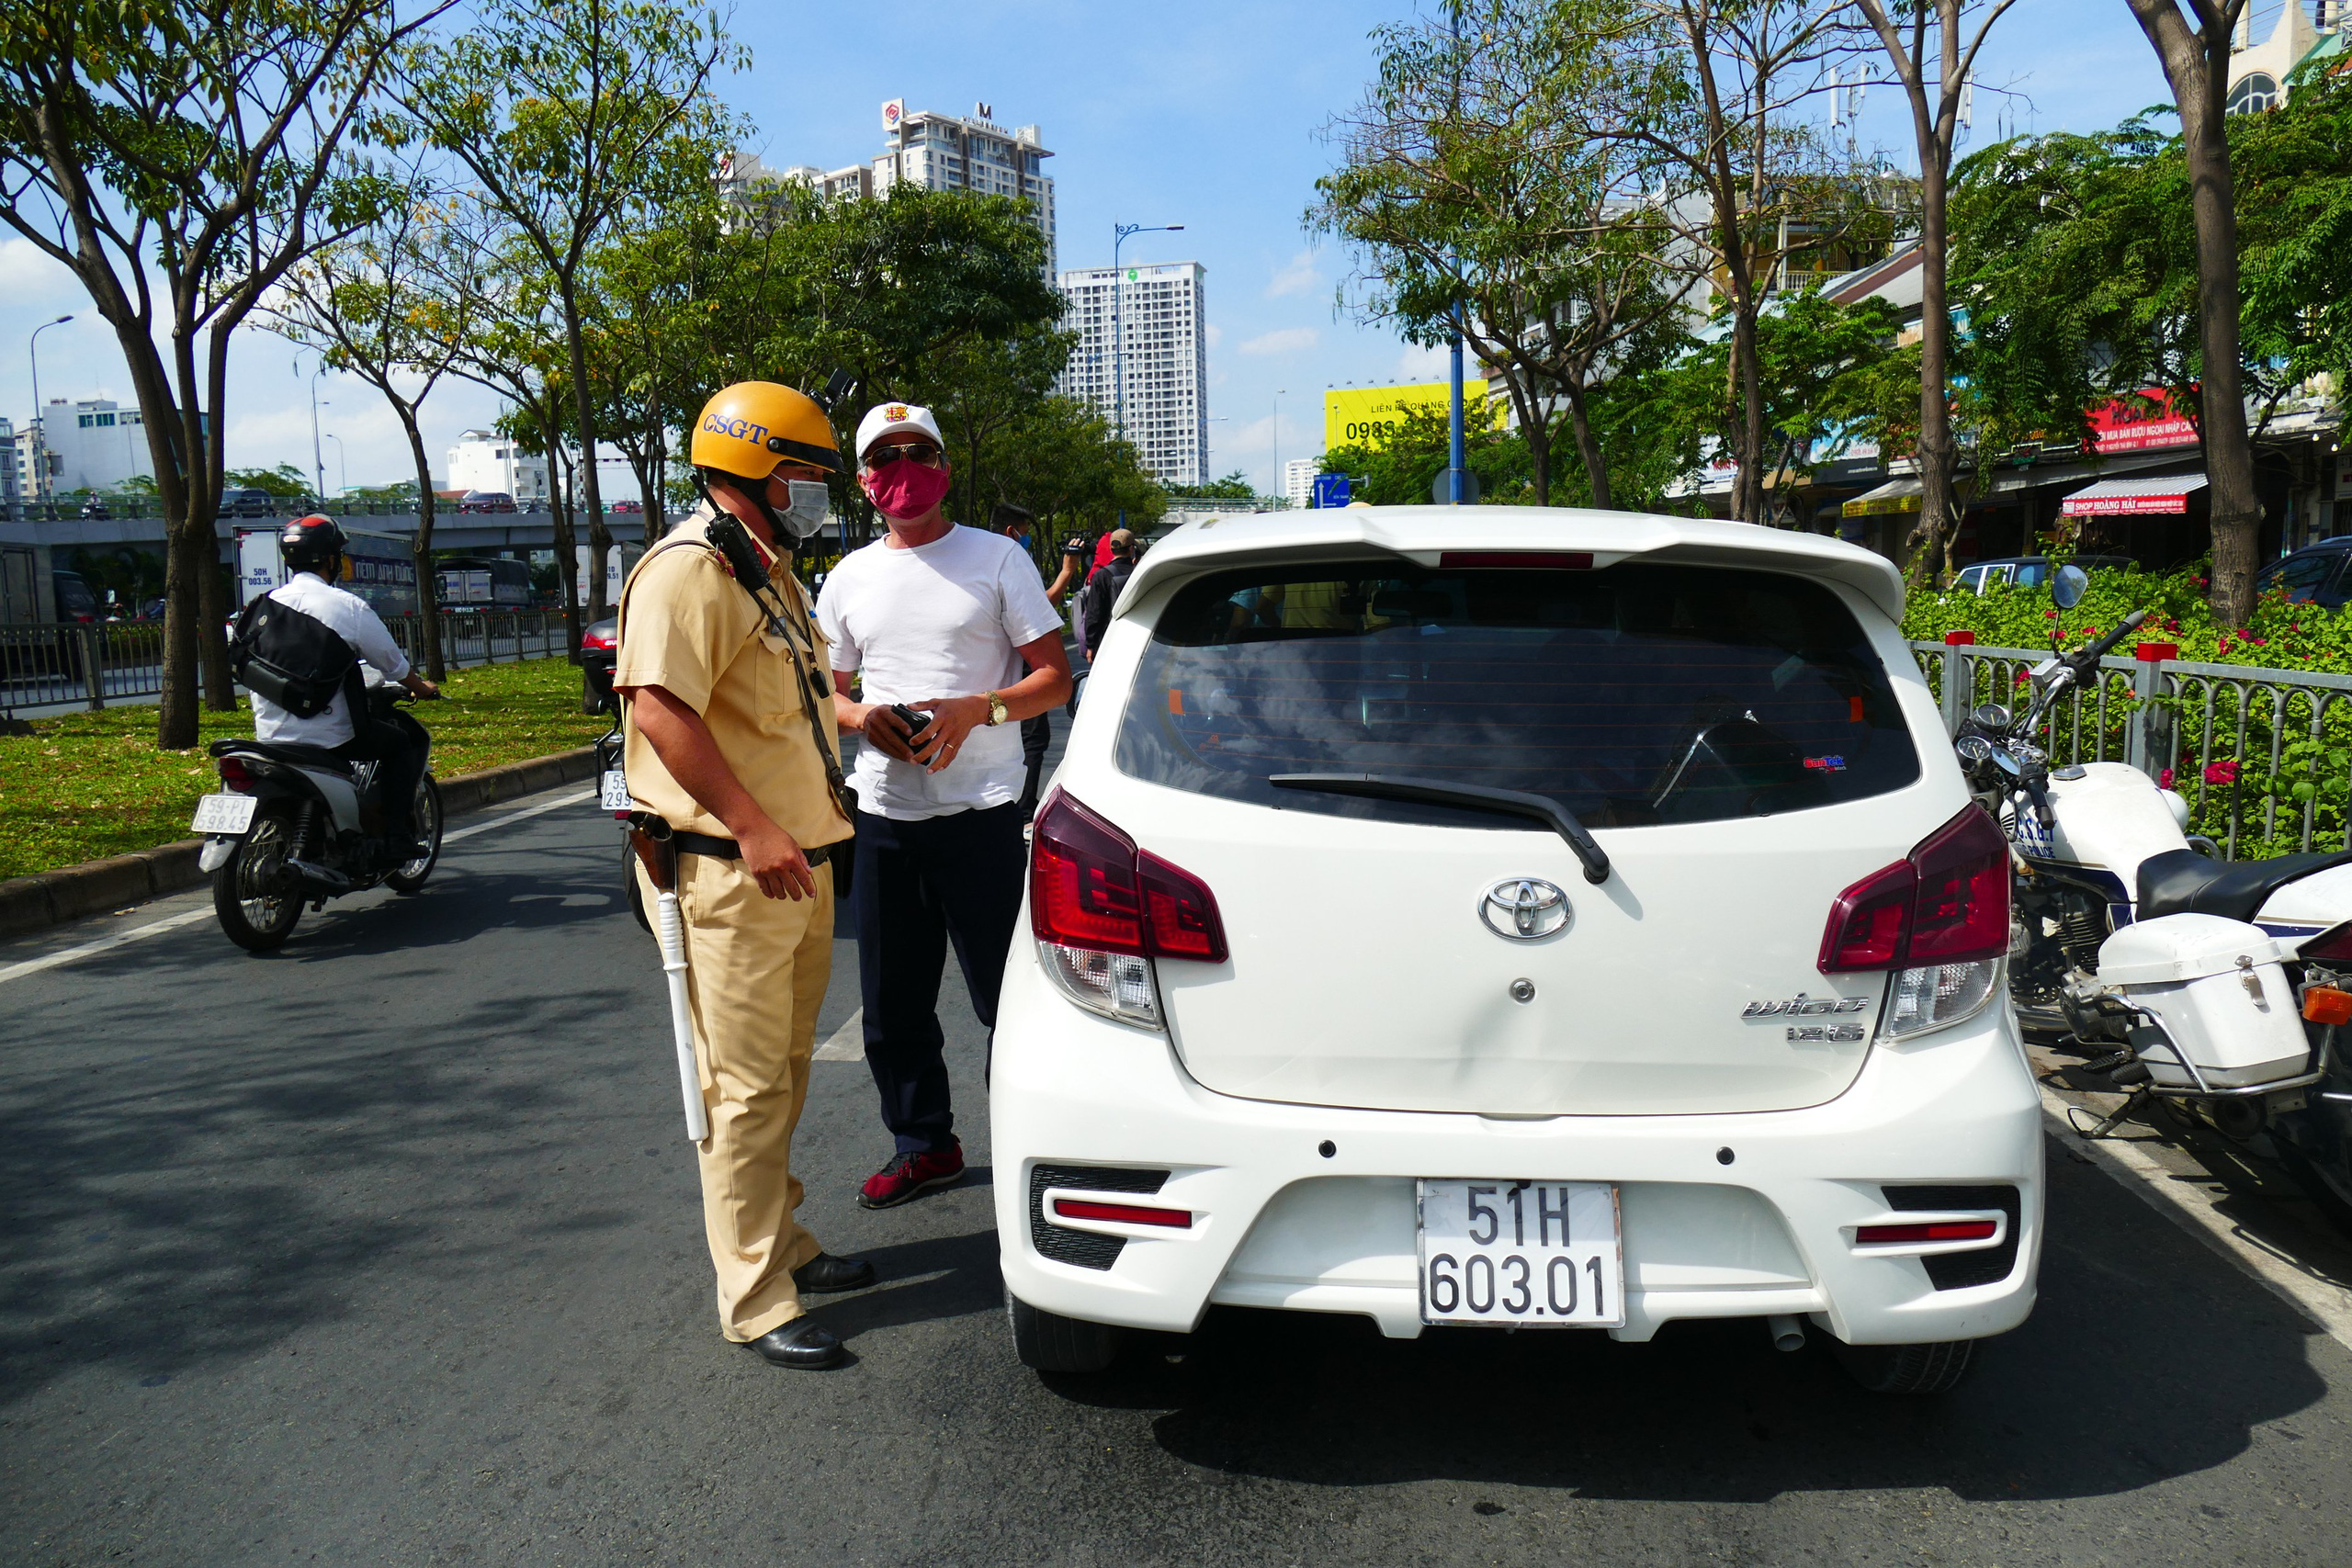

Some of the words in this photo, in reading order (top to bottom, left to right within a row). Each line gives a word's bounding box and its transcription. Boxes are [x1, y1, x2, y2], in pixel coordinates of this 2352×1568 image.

[1371, 402, 1392, 413] LIÊN
[703, 413, 769, 445] CSGT
[2107, 429, 2119, 441] MUA
[2119, 426, 2131, 439] BÁN
[2146, 423, 2165, 436] NGOẠI
[2075, 502, 2094, 511] SHOP
[2094, 499, 2120, 511] HOÀNG
[2121, 497, 2136, 510] HẢI
[254, 568, 267, 577] 50H
[248, 577, 272, 586] 003.56
[1804, 755, 1844, 769] SunTek
[208, 798, 247, 815] 59-P1
[197, 814, 248, 831] 598.45
[2028, 845, 2056, 859] POLICE
[1786, 1022, 1866, 1043] 1.2G
[1467, 1186, 1570, 1247] 51H
[1430, 1253, 1604, 1316] 603.01
